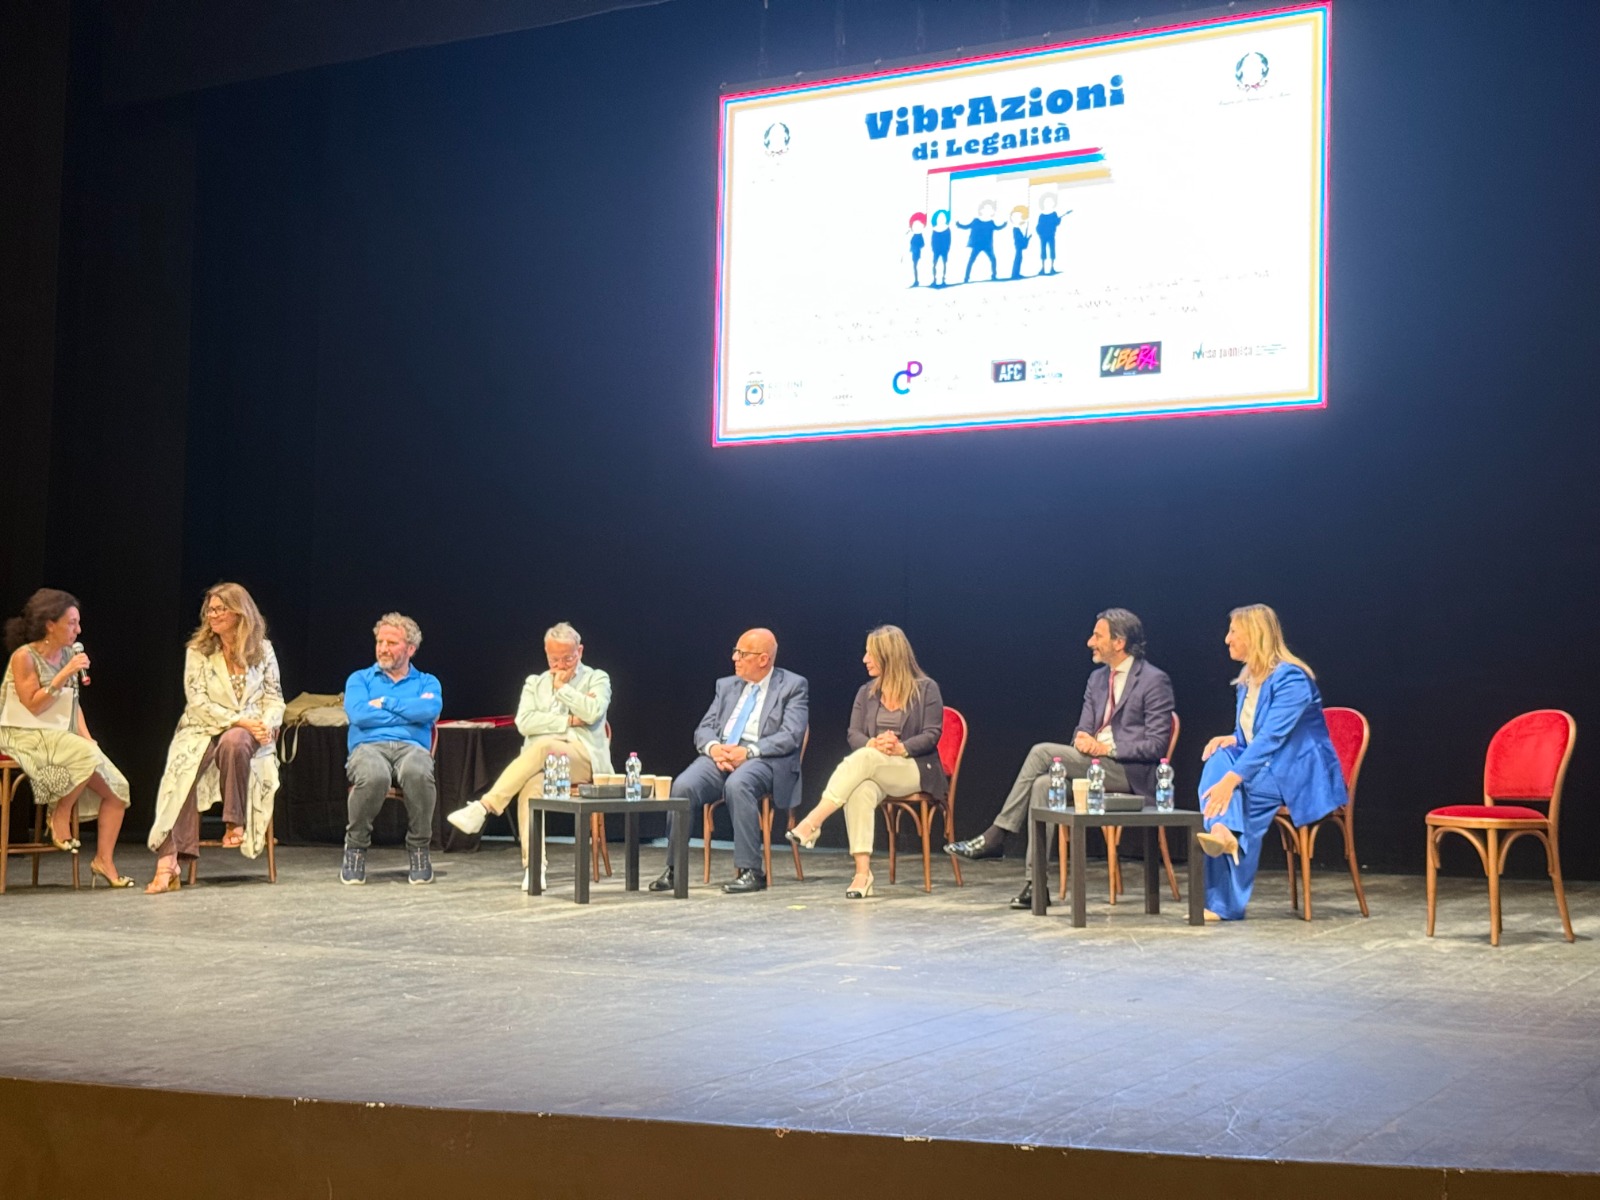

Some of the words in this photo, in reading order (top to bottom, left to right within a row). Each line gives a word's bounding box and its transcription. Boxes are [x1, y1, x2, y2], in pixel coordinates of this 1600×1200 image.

[865, 74, 1125, 140] VibrAzioni
[912, 141, 939, 161] di
[946, 123, 1070, 156] Legalità
[998, 364, 1023, 381] AFC
